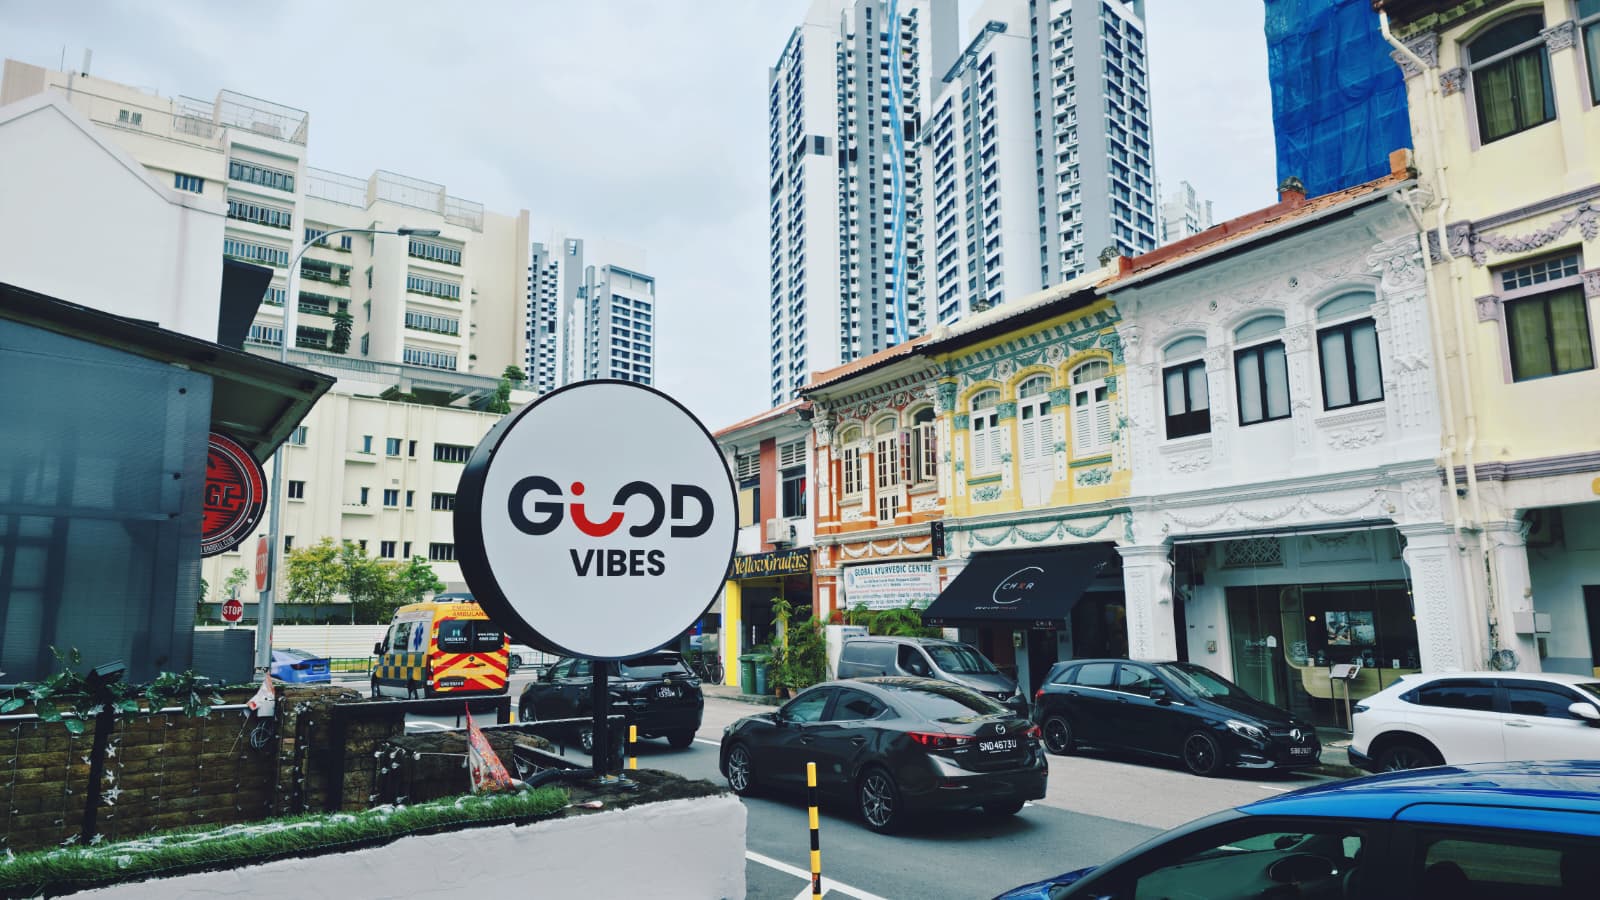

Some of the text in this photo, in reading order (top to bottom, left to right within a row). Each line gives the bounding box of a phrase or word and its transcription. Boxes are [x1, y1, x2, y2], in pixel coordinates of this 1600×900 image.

[256, 554, 267, 574] STOP
[570, 549, 666, 577] VIBES
[855, 567, 873, 577] GLOBAL
[874, 565, 906, 575] AYURVEDIC
[908, 564, 932, 573] CENTRE
[222, 605, 242, 615] STOP
[979, 740, 1017, 751] SND4673U
